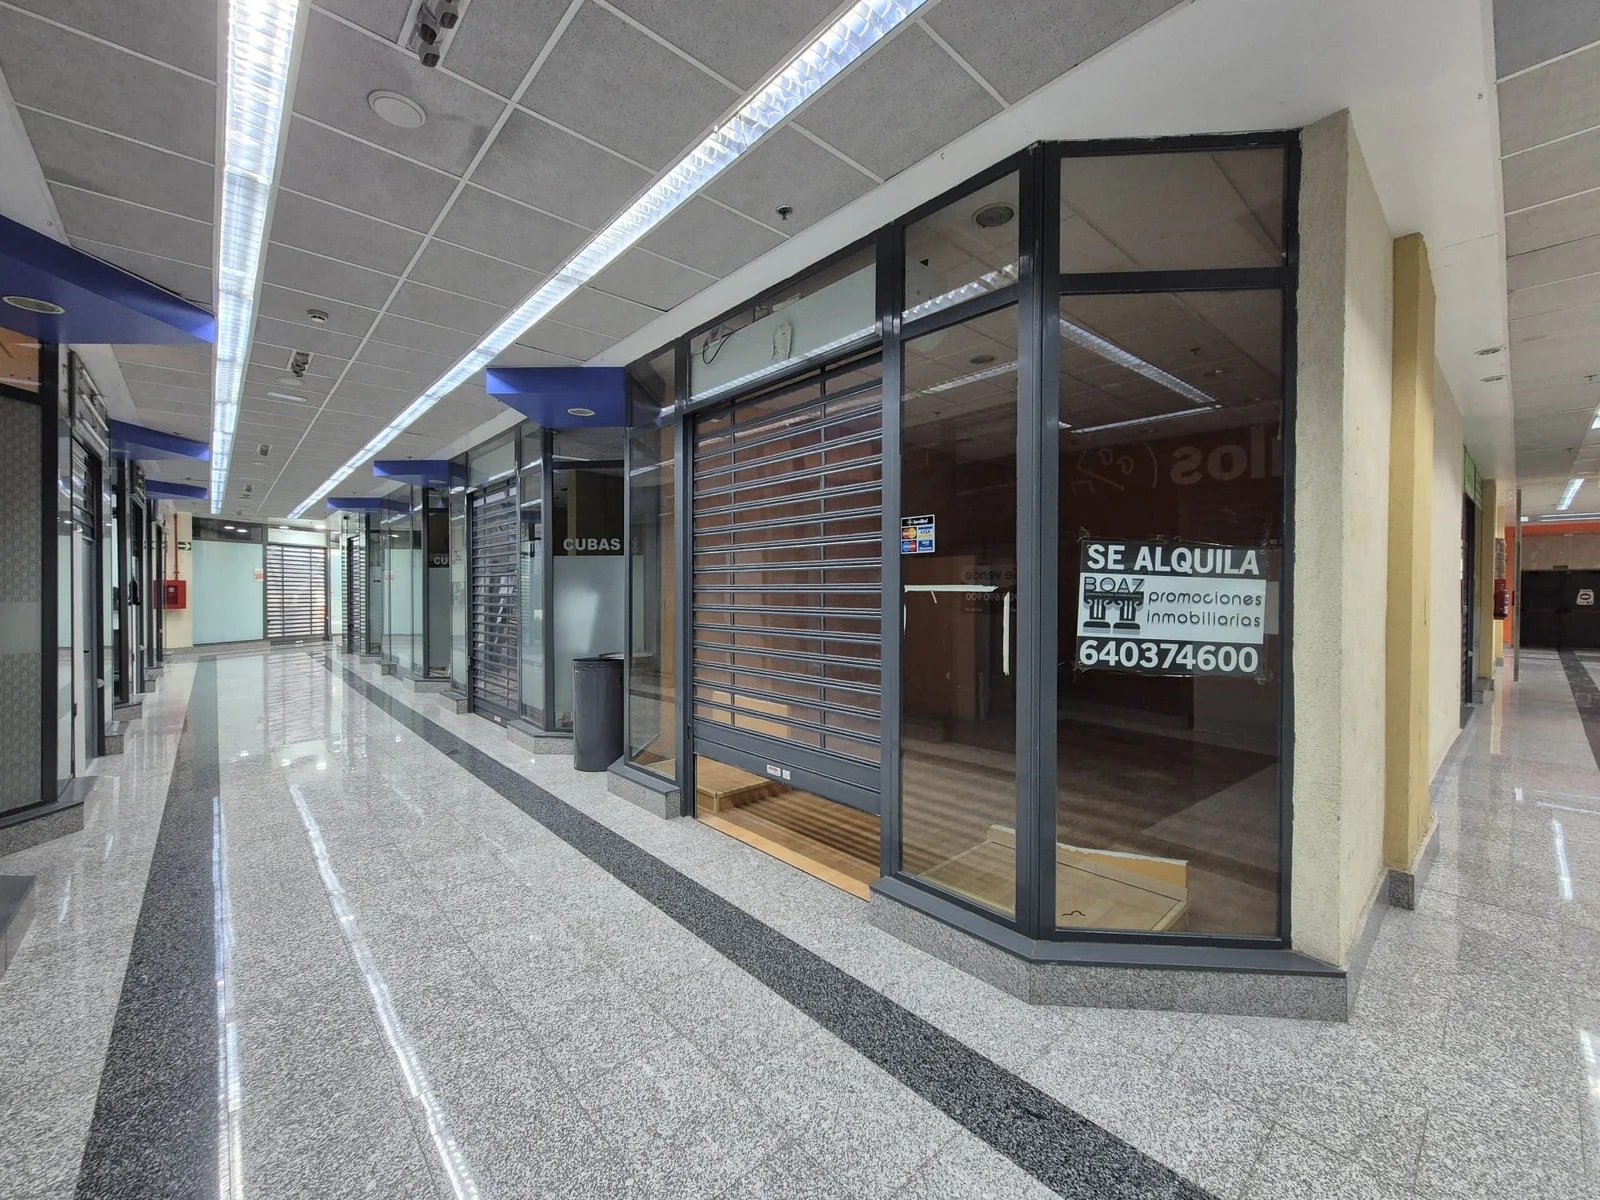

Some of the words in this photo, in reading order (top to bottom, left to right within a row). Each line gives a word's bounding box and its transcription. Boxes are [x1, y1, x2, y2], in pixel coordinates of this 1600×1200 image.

[563, 537, 621, 551] CUBAS
[1087, 544, 1125, 570] SE
[1134, 546, 1260, 575] ALQUILA
[1084, 576, 1145, 594] BOAZ
[1148, 591, 1263, 606] promociones
[1147, 610, 1261, 627] inmobiliarias
[1079, 639, 1259, 673] 640374600
